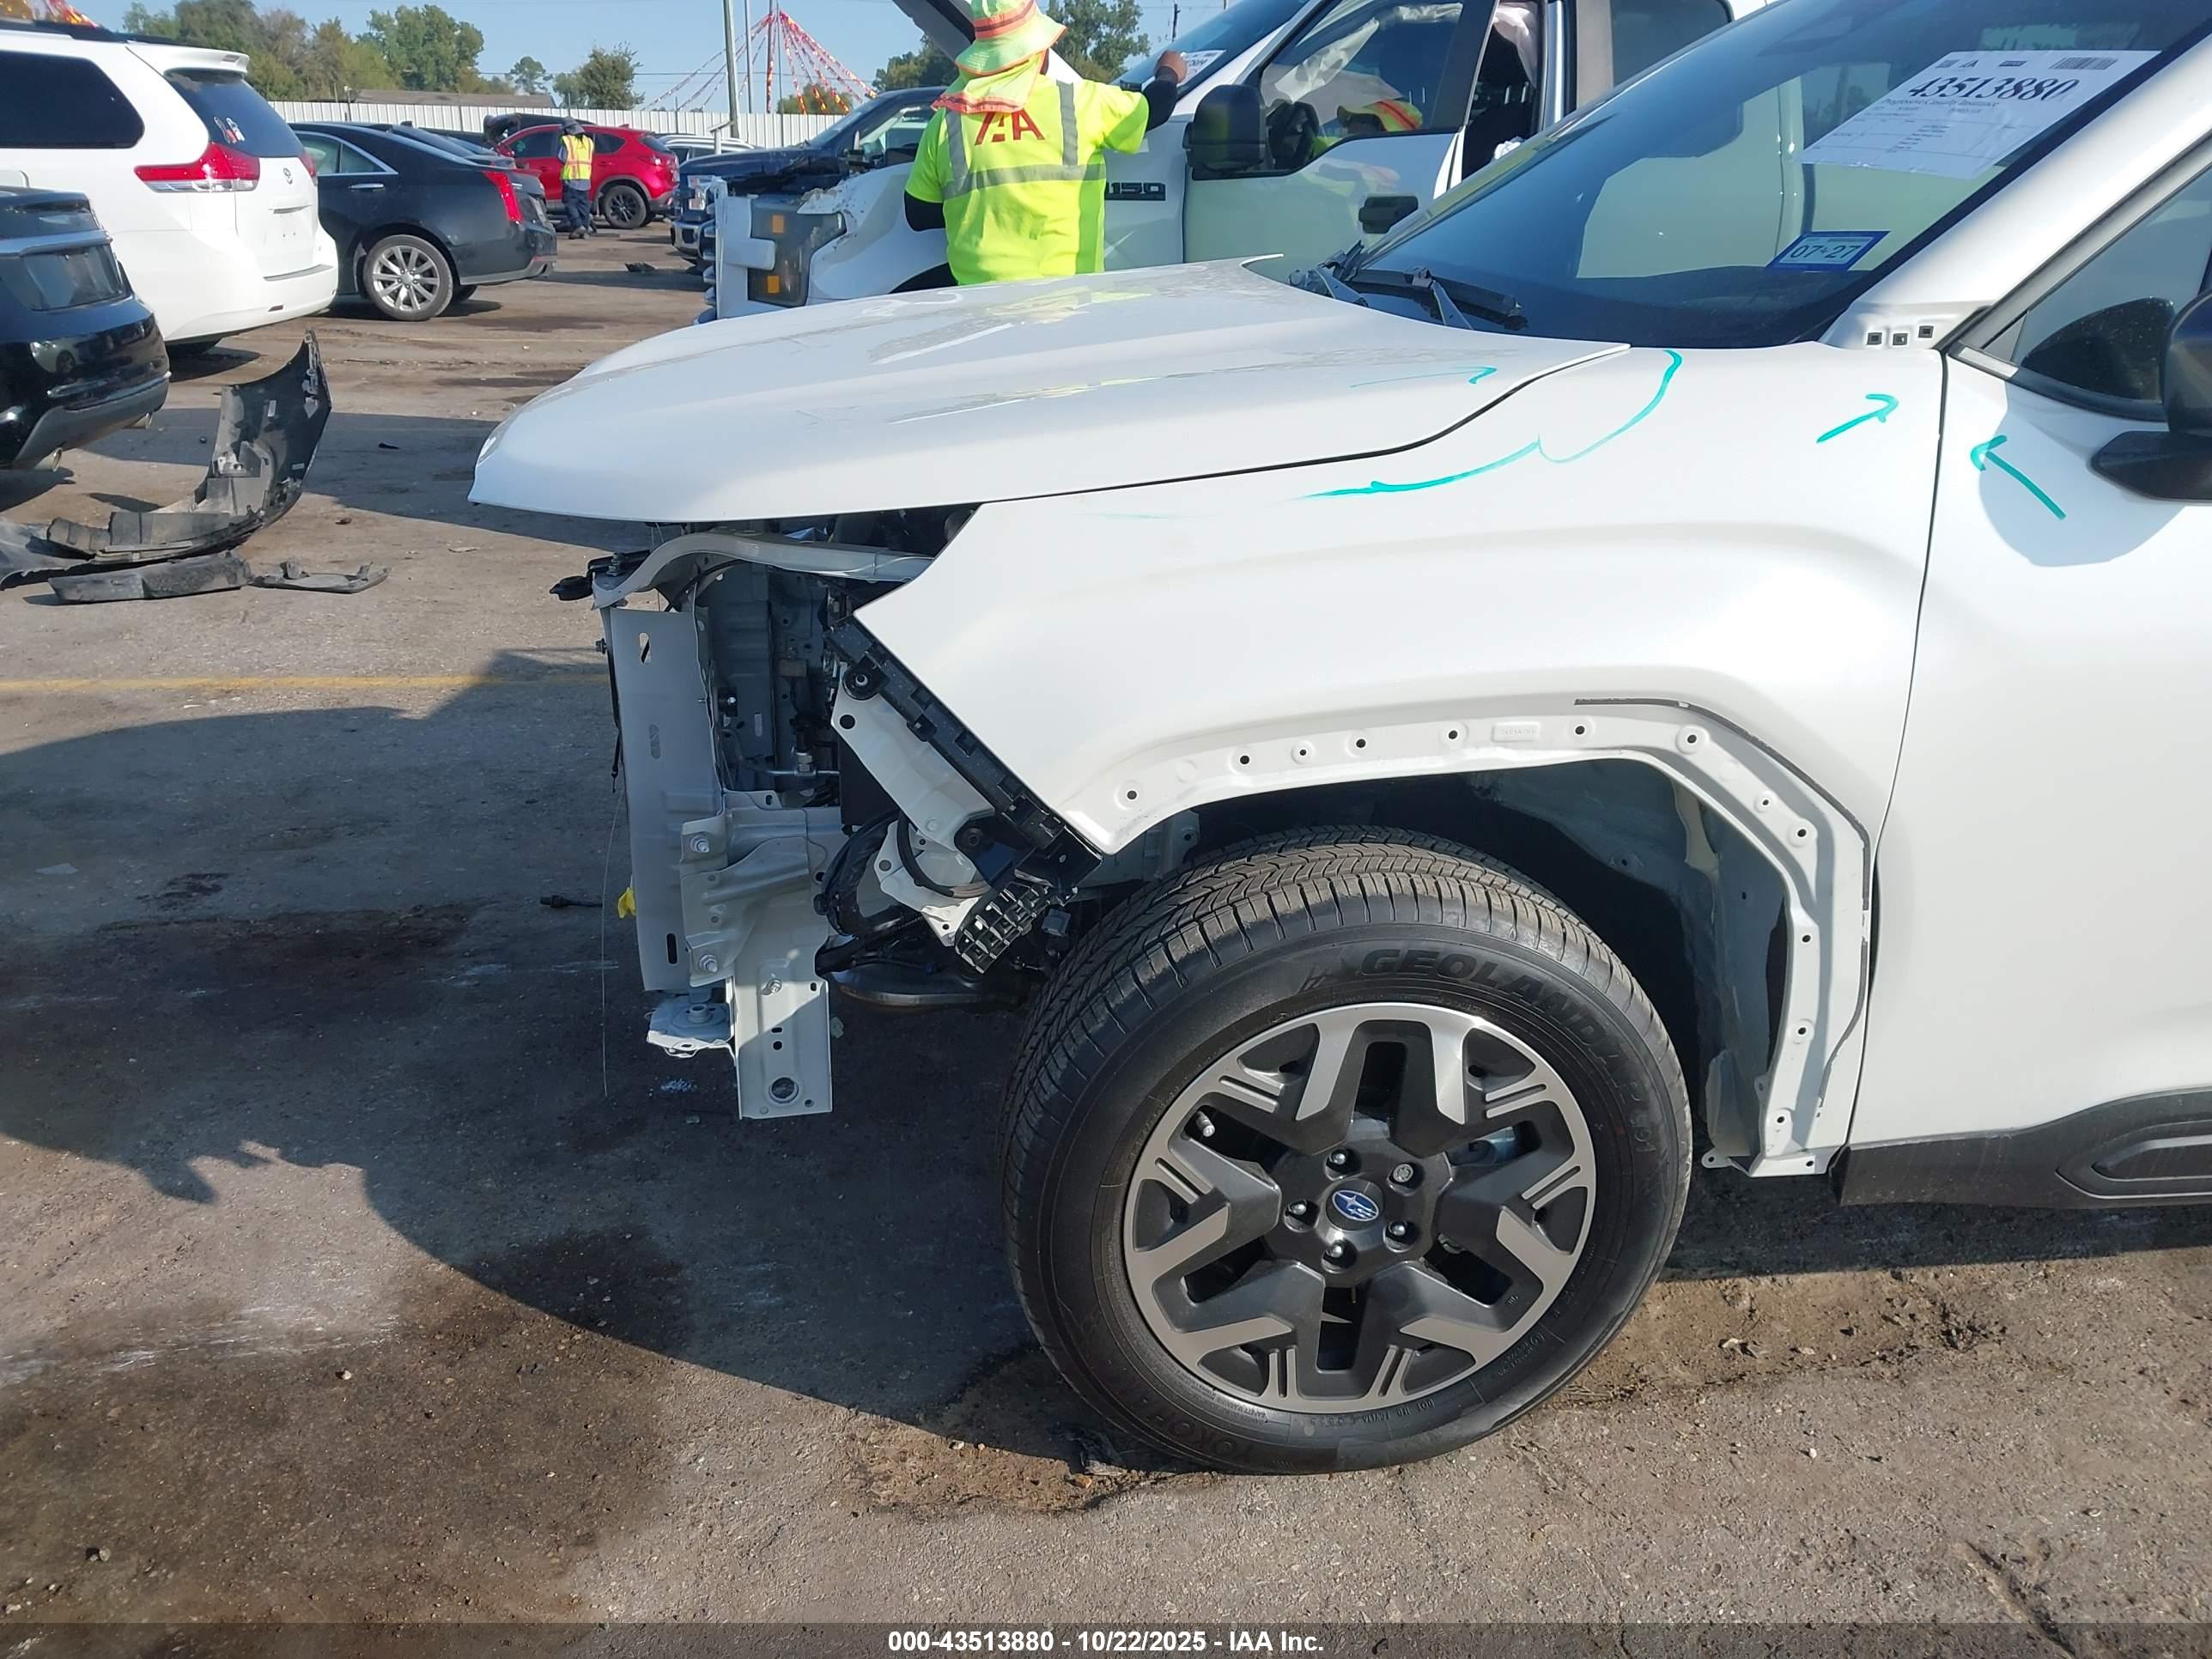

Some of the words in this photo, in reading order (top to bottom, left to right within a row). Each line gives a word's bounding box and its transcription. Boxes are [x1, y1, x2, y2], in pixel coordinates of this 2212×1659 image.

[1908, 76, 2080, 100] 43513880
[1105, 182, 1166, 200] 150
[1790, 245, 1823, 258] 07
[1825, 245, 1862, 258] 27
